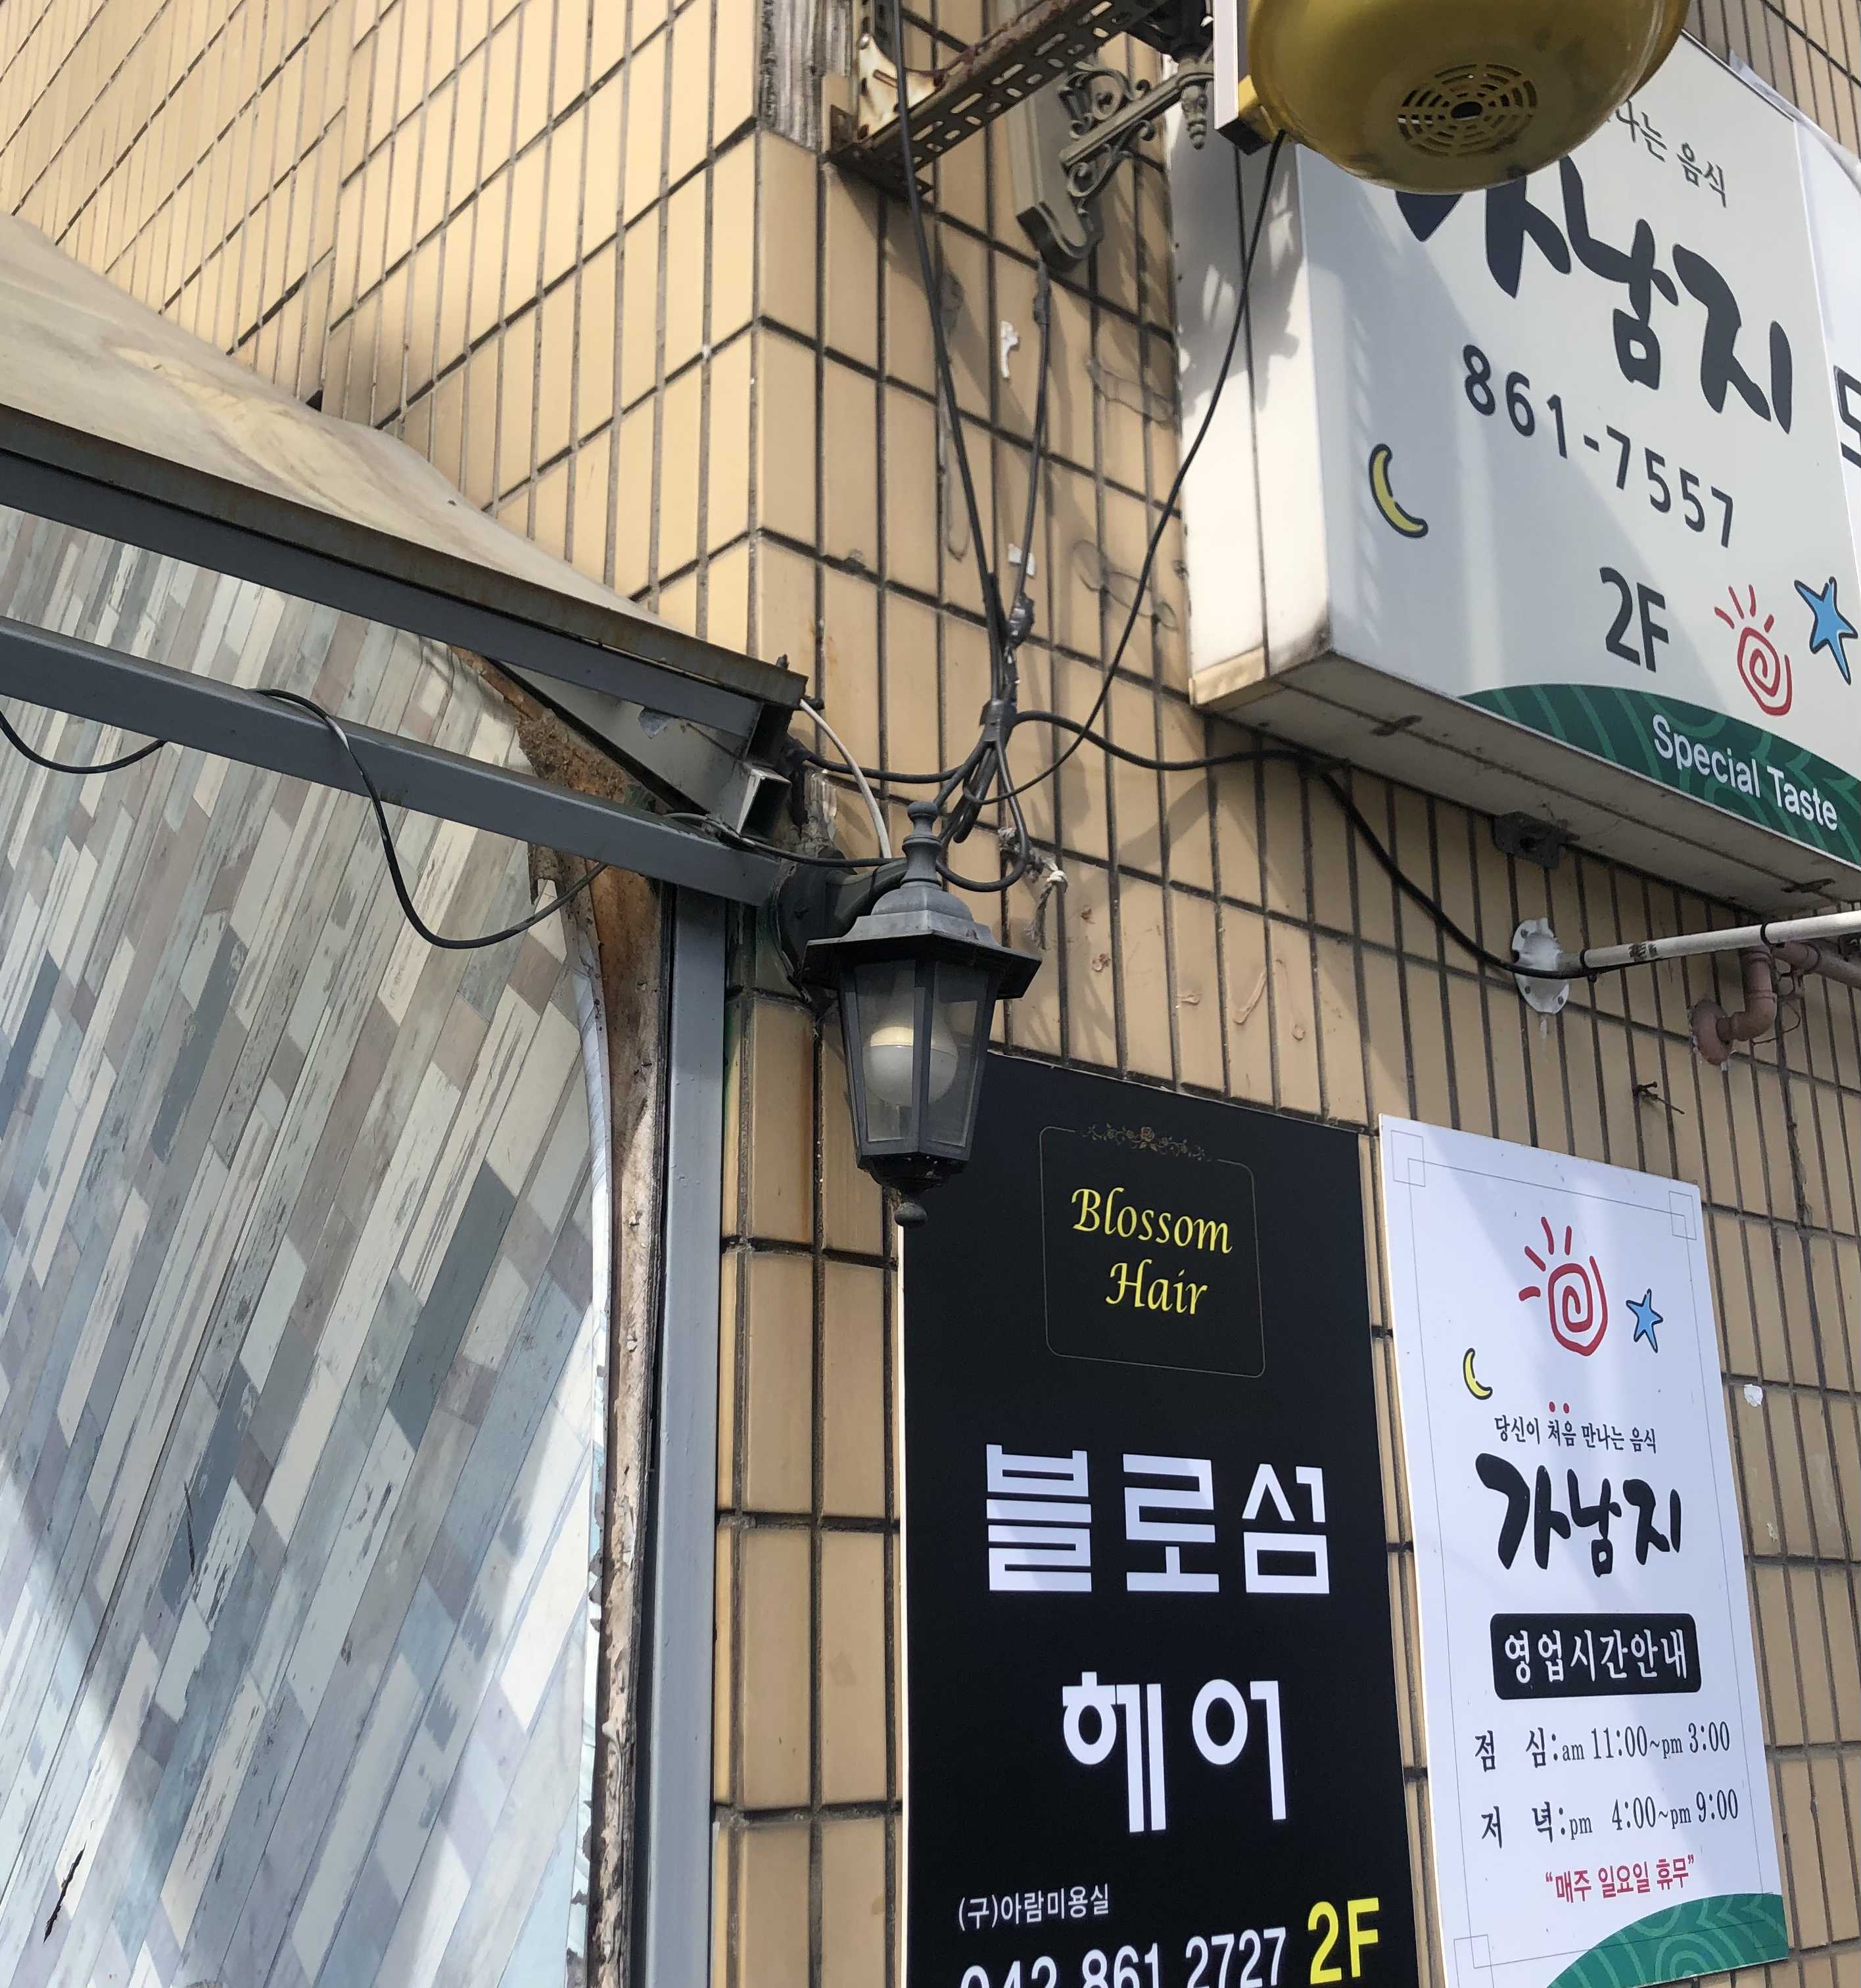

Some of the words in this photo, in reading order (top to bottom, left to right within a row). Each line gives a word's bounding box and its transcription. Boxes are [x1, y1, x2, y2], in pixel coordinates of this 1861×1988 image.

[1676, 142, 1726, 208] 음식
[1463, 345, 1733, 548] 861-7557
[1599, 567, 1669, 673] 2F
[1652, 715, 1760, 797] Special
[1767, 767, 1838, 831] Taste
[1072, 1187, 1233, 1253] Blossom
[1105, 1259, 1208, 1314] Hair
[1494, 1415, 1540, 1445] 당신이
[1547, 1419, 1577, 1446] 처음
[1581, 1423, 1625, 1450] 만나는
[1629, 1427, 1657, 1454] 음식
[986, 1444, 1330, 1594] 블로섬
[1475, 1452, 1682, 1578] 가남지
[1505, 1628, 1687, 1683] 영업시간안내
[1474, 1730, 1496, 1772] 점
[1687, 1721, 1730, 1753] 3:00
[1481, 1805, 1502, 1849] 저
[1696, 1789, 1738, 1822] 9:00
[958, 1883, 1110, 1931] (구)아람미용실
[1598, 1861, 1651, 1899] 일요일
[1082, 1942, 1159, 1988] 861
[1186, 1927, 1287, 1988] 2727
[1307, 1897, 1379, 1984] 2F
